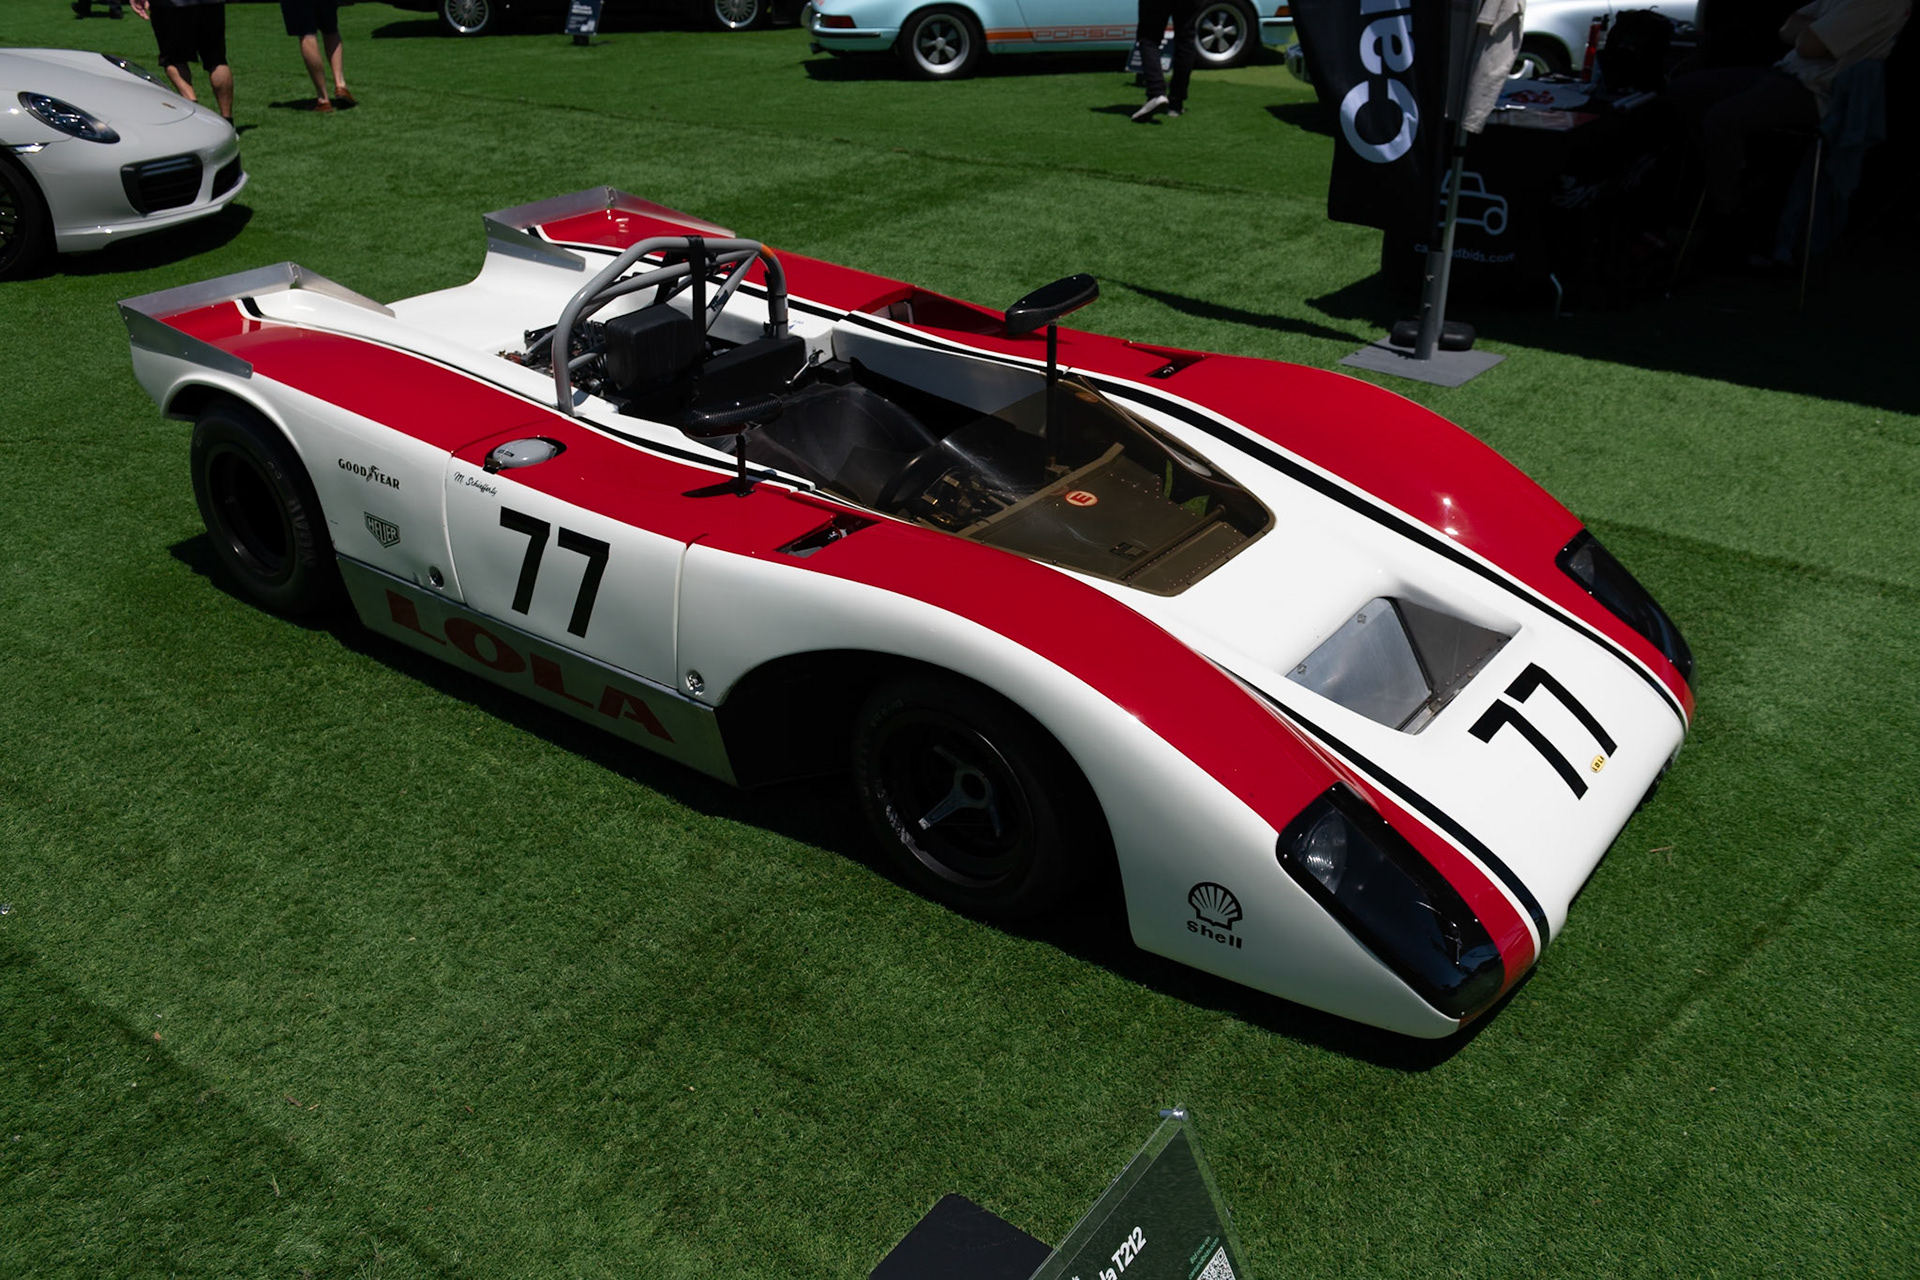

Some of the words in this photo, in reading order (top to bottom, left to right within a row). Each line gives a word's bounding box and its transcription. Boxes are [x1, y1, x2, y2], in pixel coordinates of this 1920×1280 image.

[1036, 28, 1138, 40] PORSCH
[1414, 243, 1515, 263] cadbids.com
[338, 458, 400, 490] GOODYEAR
[367, 516, 398, 543] HEUER
[499, 507, 610, 638] 77
[386, 589, 676, 743] LOLA
[1468, 662, 1618, 800] 77
[1186, 920, 1243, 949] Shell
[1098, 1267, 1118, 1280] la
[1111, 1226, 1147, 1273] T212
